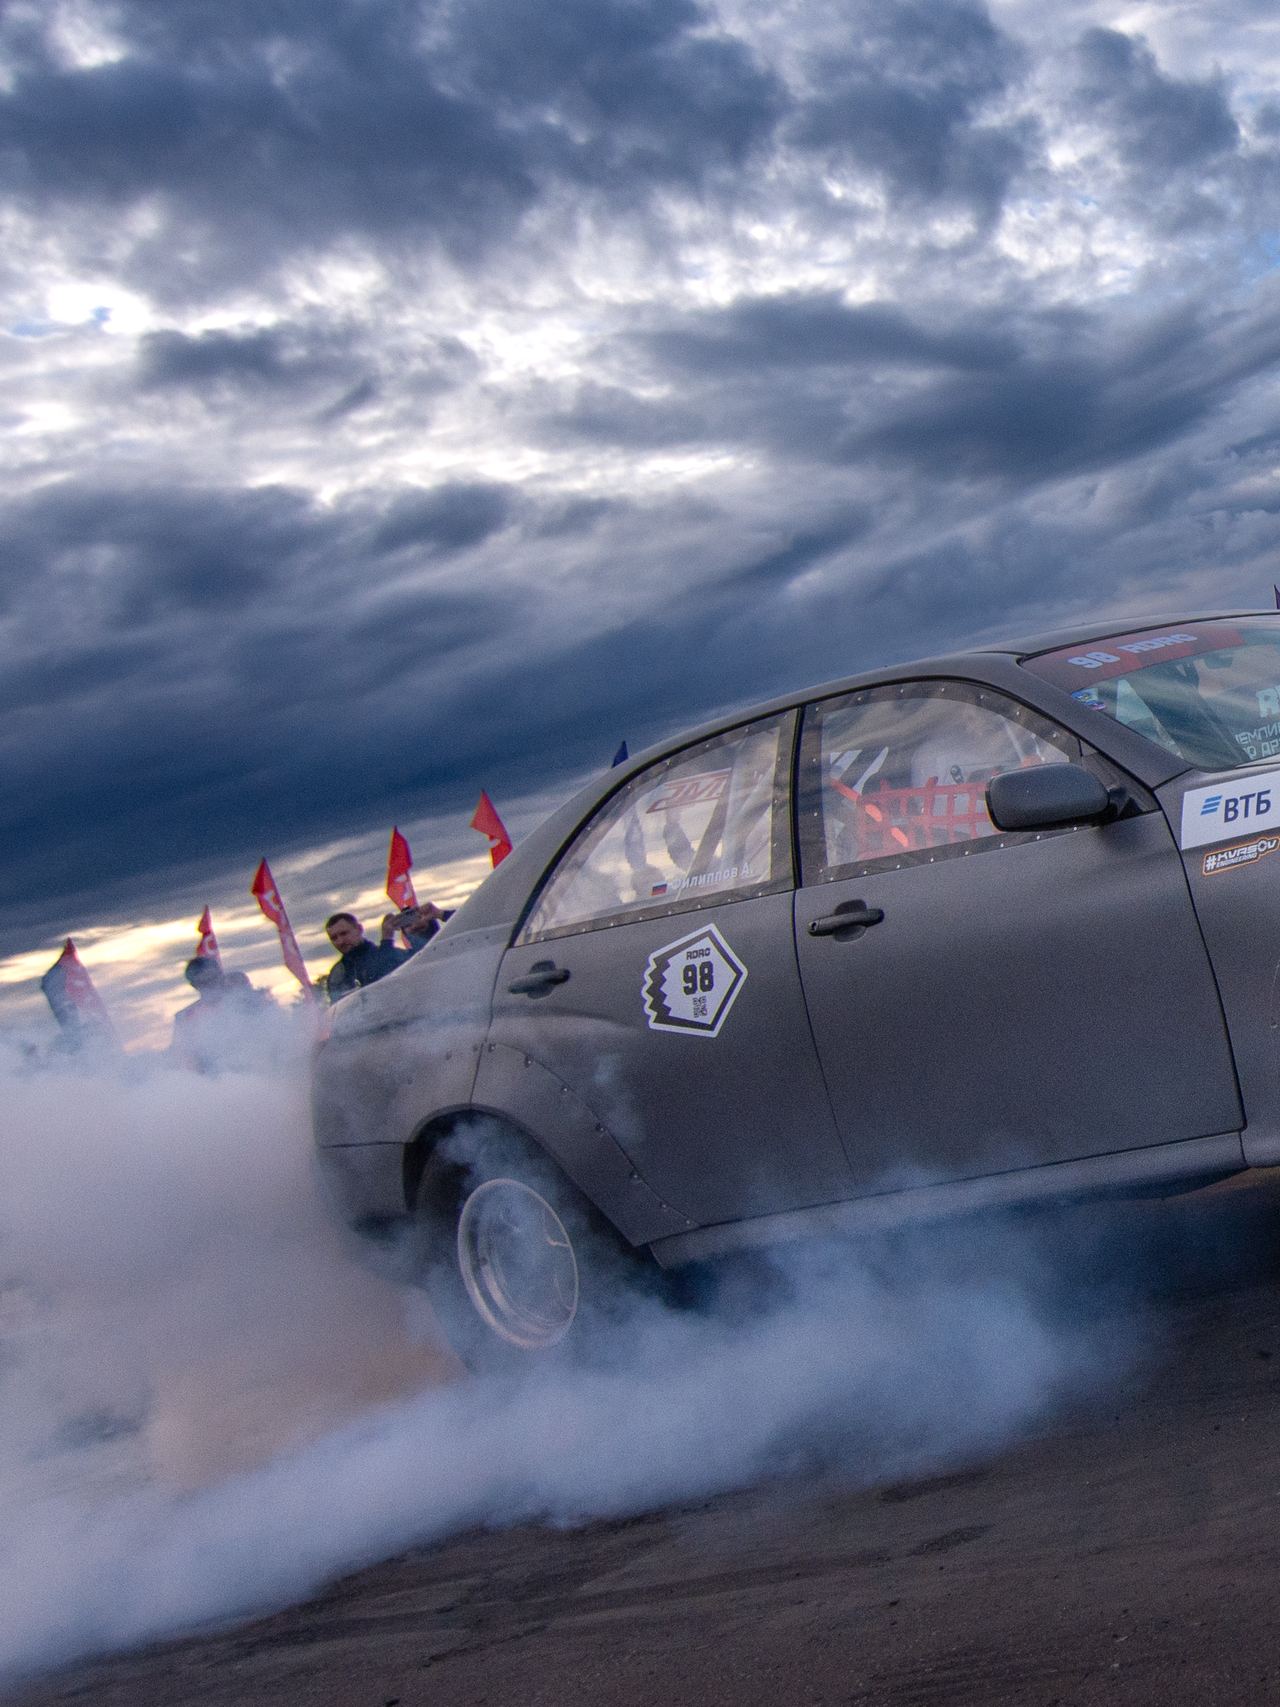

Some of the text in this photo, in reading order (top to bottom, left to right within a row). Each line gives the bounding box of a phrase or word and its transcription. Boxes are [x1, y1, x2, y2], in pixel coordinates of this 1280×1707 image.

[1067, 633, 1198, 669] 98 RDRC
[1224, 789, 1272, 823] ВТБ
[685, 947, 711, 960] RDRC
[682, 961, 715, 996] 98
